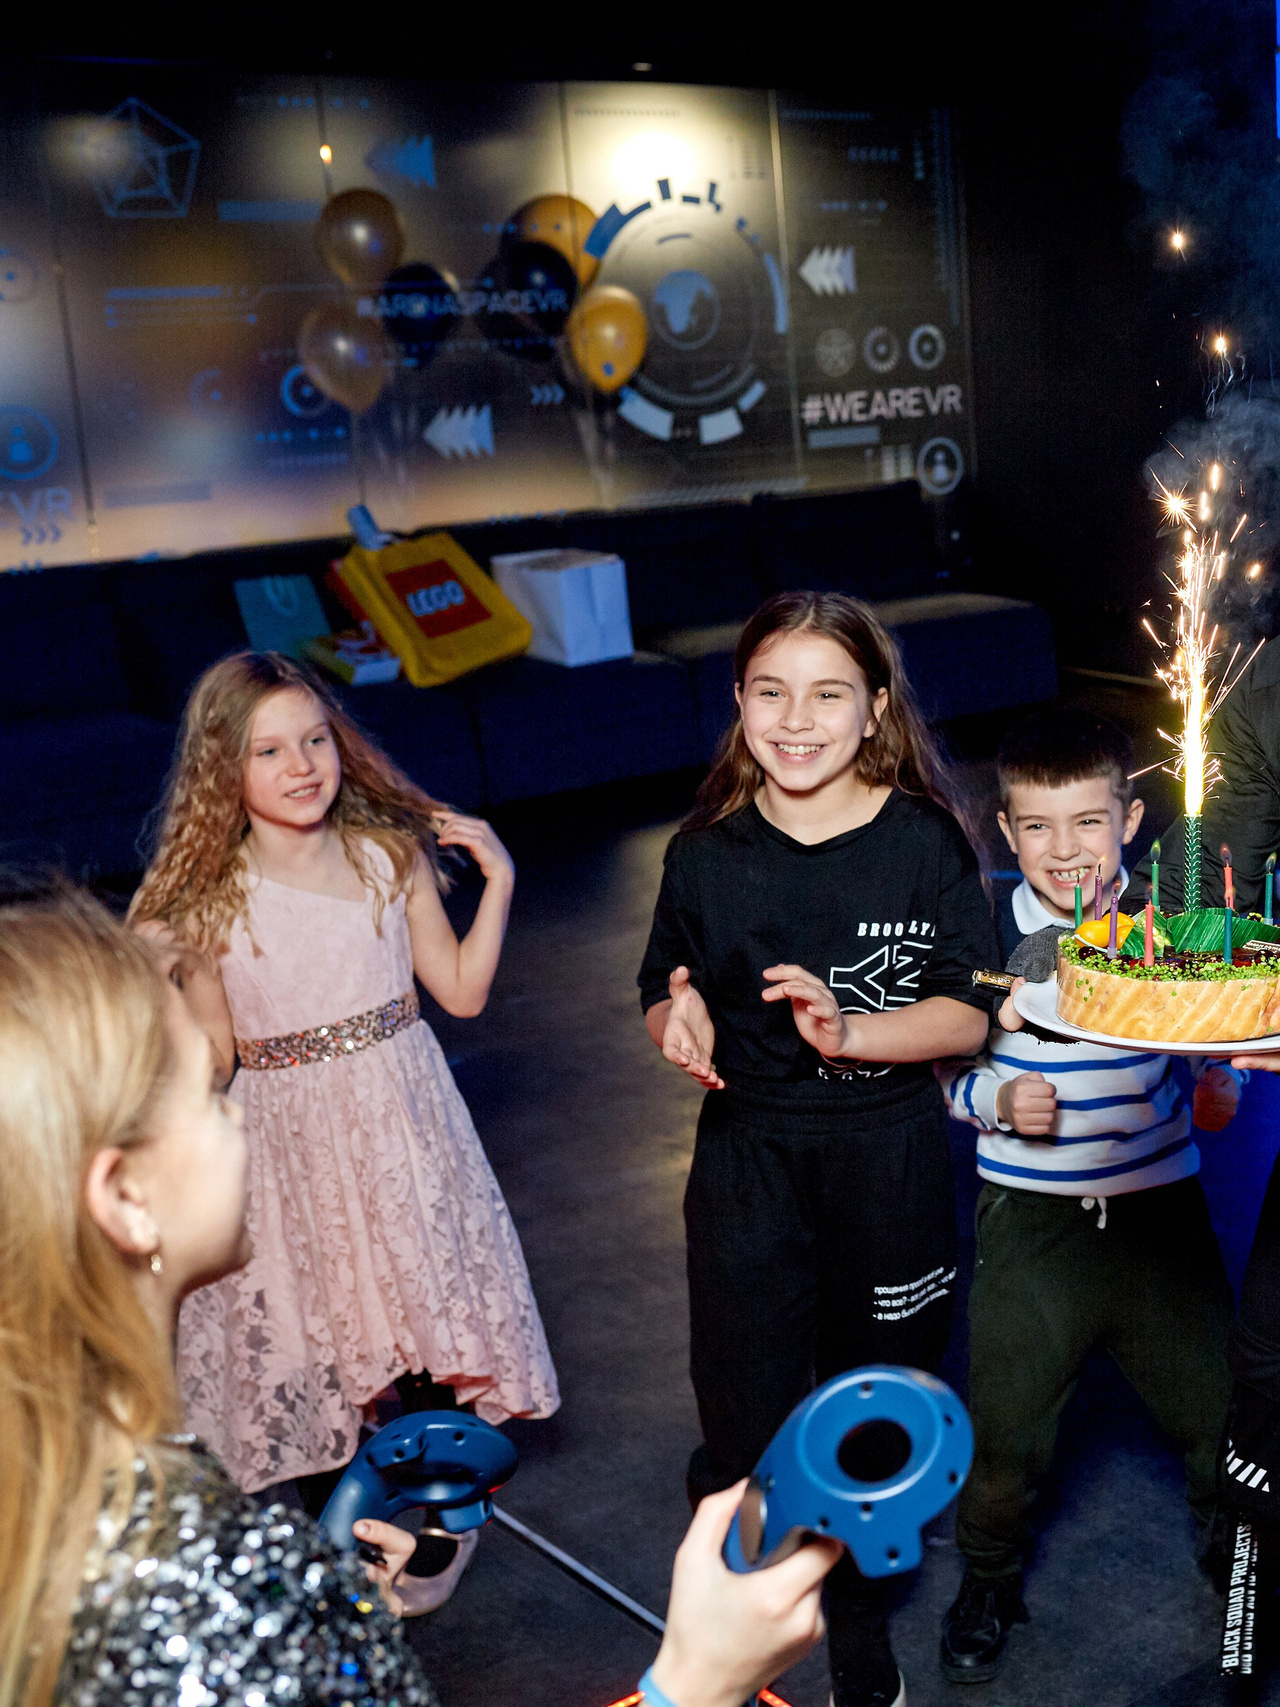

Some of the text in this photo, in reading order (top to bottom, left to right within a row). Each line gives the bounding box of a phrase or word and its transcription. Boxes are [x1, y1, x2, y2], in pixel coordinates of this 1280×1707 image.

[802, 383, 963, 425] #WEAREVR
[406, 580, 465, 618] LEGO
[1230, 1524, 1252, 1586] PROJECTS
[1226, 1586, 1245, 1628] SQUAD
[1222, 1628, 1241, 1668] BLACK
